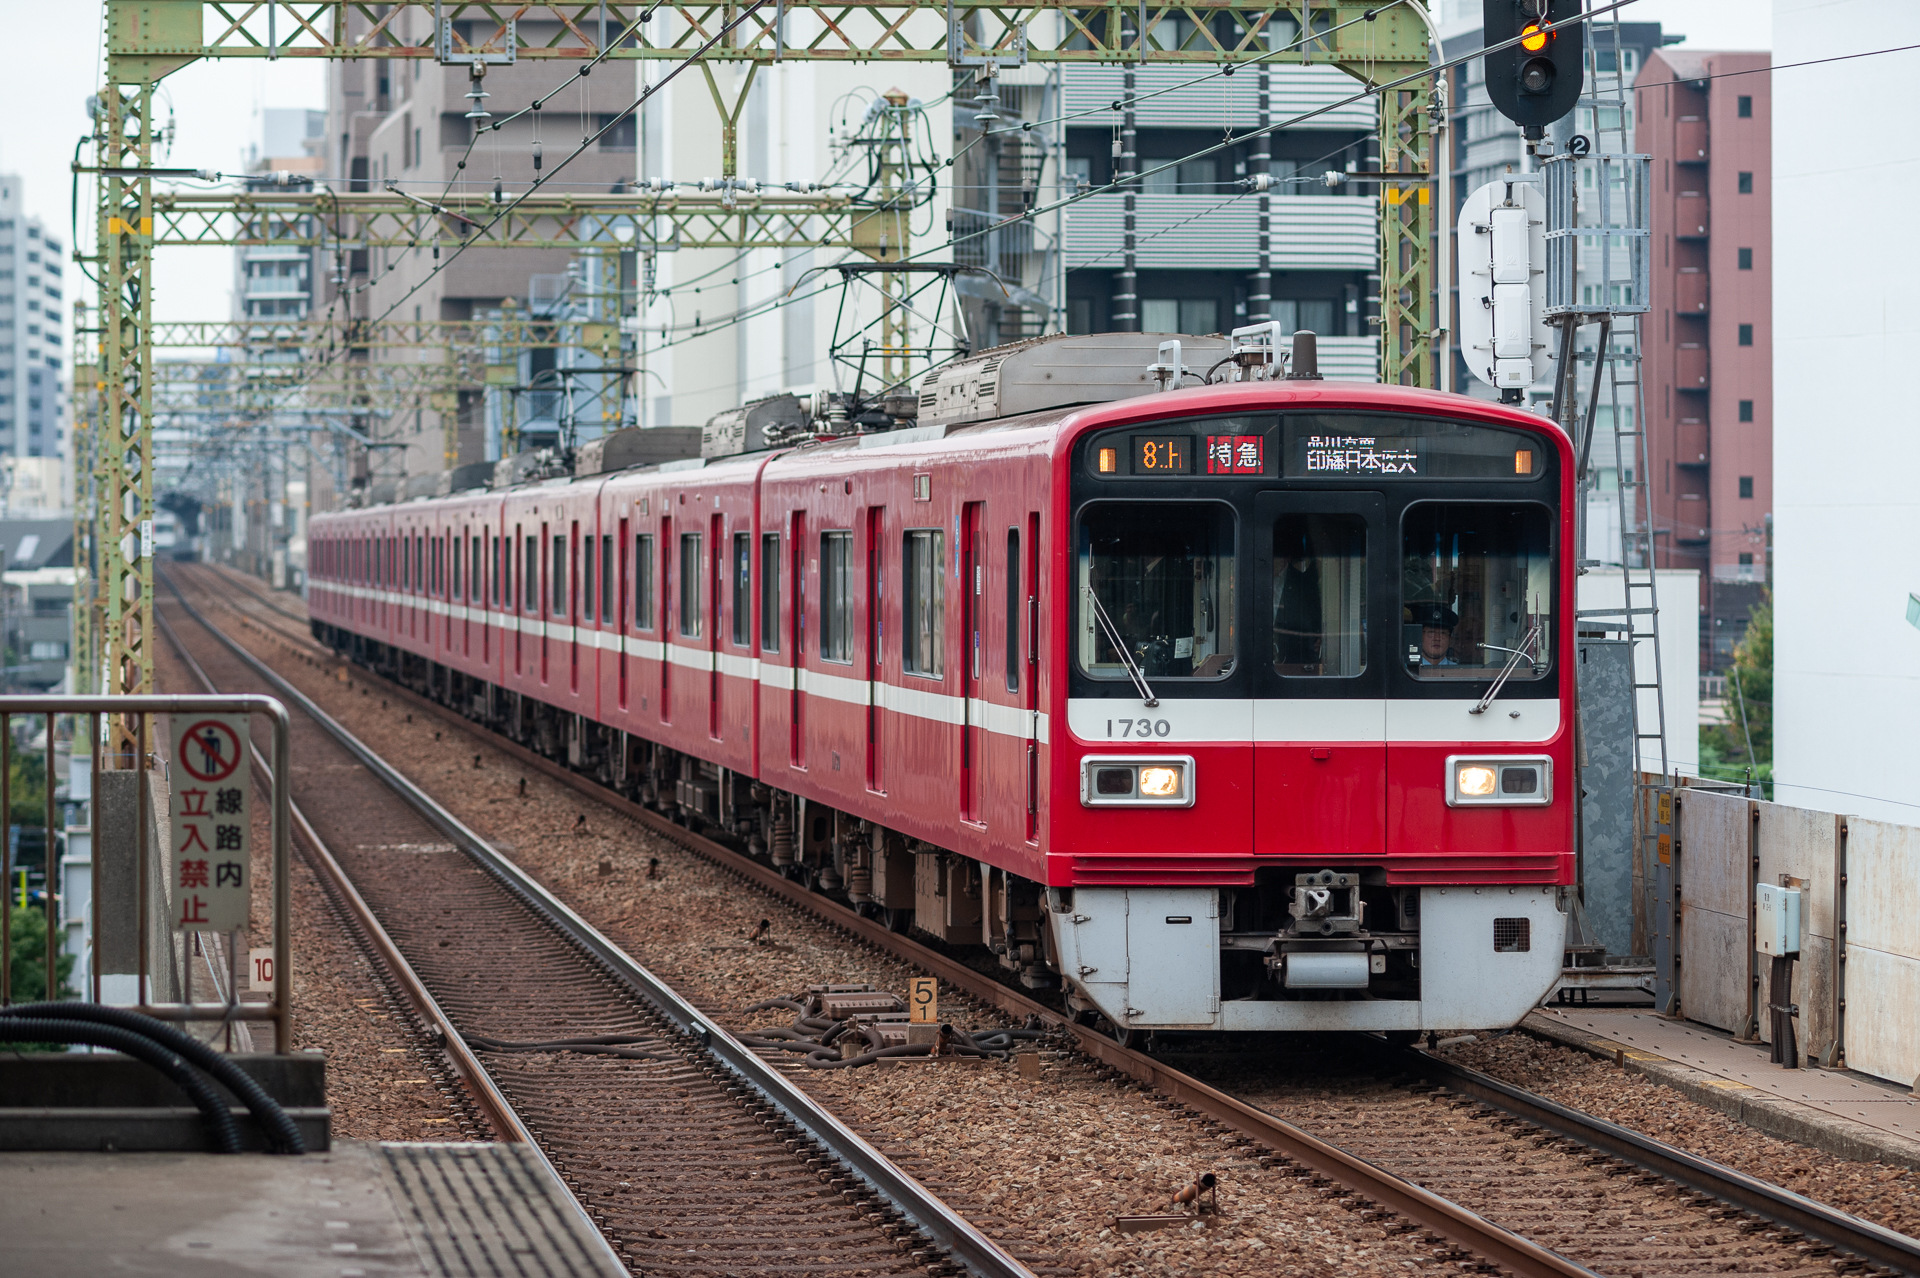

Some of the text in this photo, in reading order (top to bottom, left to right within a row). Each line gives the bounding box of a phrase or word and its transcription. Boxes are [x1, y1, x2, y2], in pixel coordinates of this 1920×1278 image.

[1573, 137, 1586, 155] 2
[1209, 442, 1261, 468] 特急
[1107, 718, 1171, 738] 1730
[215, 787, 243, 888] 線路内
[179, 787, 209, 925] 立入禁止
[255, 957, 274, 982] 10
[914, 980, 933, 1005] 5
[919, 1004, 927, 1021] 1
